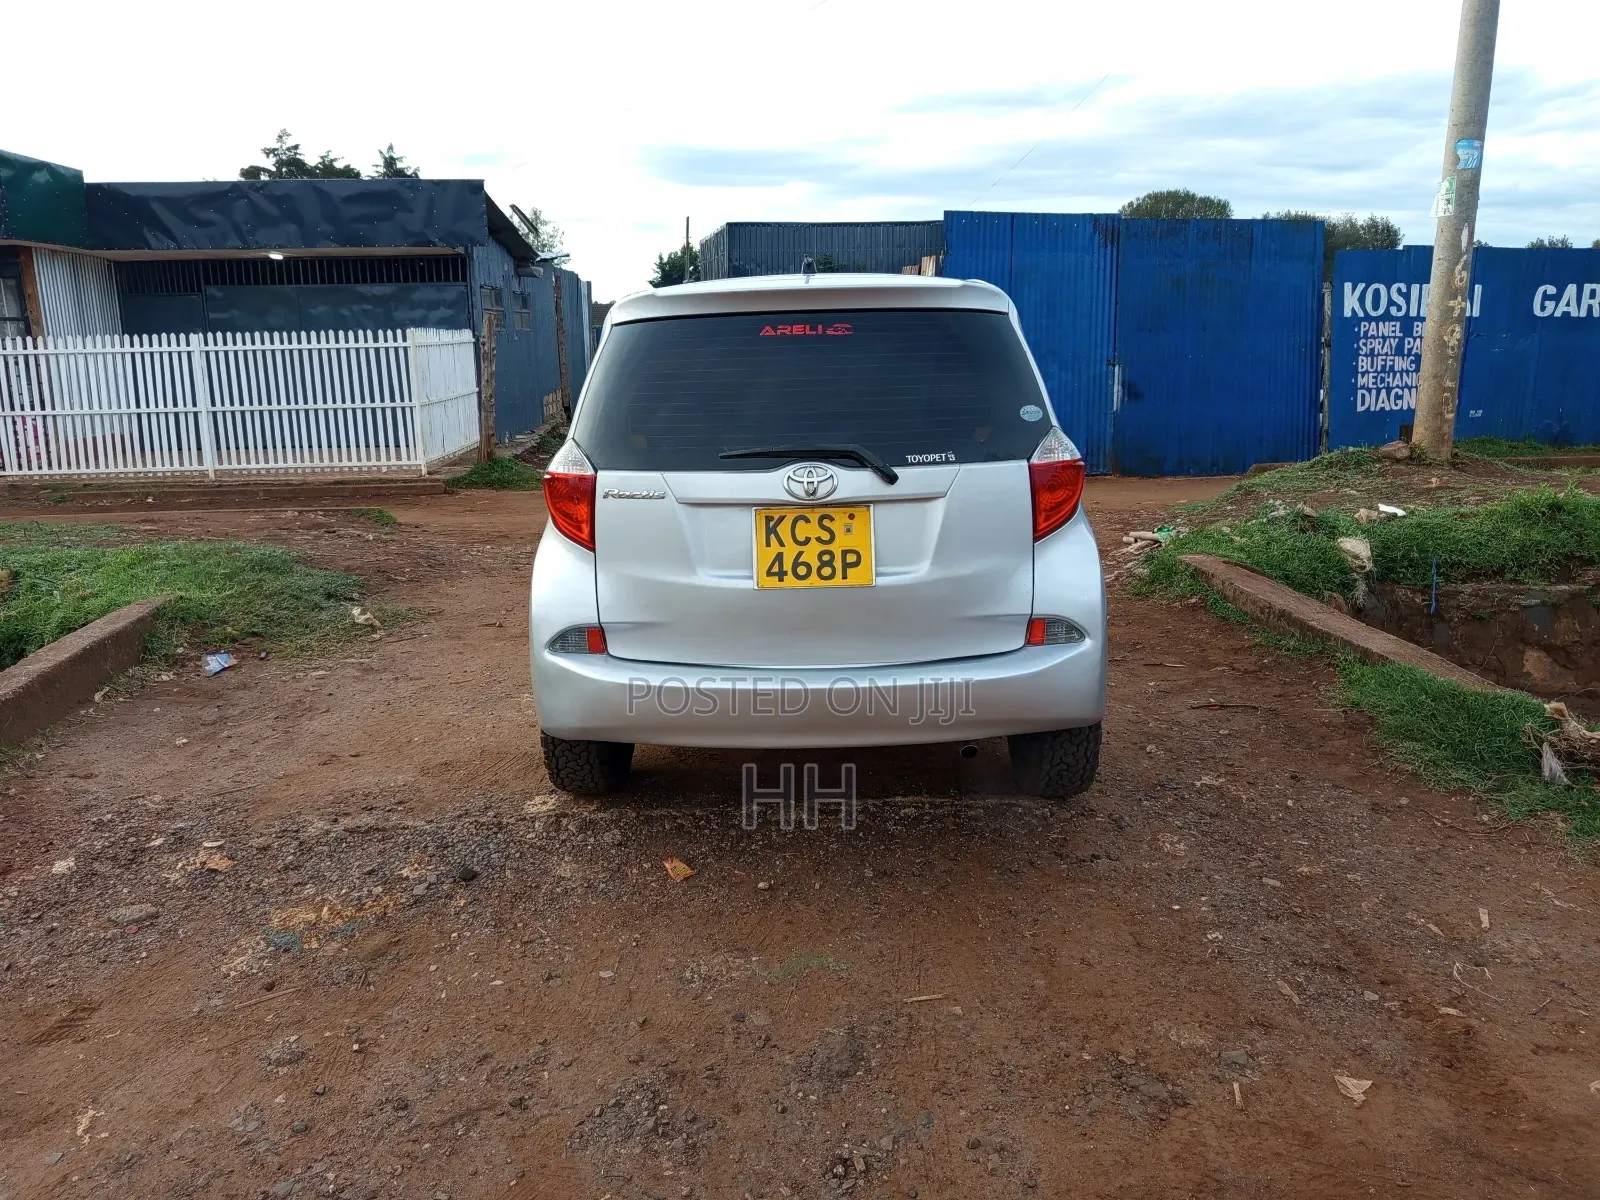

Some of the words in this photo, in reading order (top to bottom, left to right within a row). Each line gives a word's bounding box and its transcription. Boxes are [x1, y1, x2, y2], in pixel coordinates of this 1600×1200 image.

[1343, 282, 1482, 317] KOSII
[1533, 283, 1600, 317] GAR
[759, 324, 823, 336] ARELI
[1360, 322, 1403, 337] PANEL
[1359, 339, 1398, 355] SPRAY
[1404, 338, 1424, 355] PA
[1358, 356, 1415, 372] BUFFING
[1356, 388, 1417, 412] DIAGN
[905, 453, 947, 463] TOYOPET
[602, 487, 666, 500] Ractis
[764, 513, 836, 548] KCS
[765, 549, 862, 583] 468P
